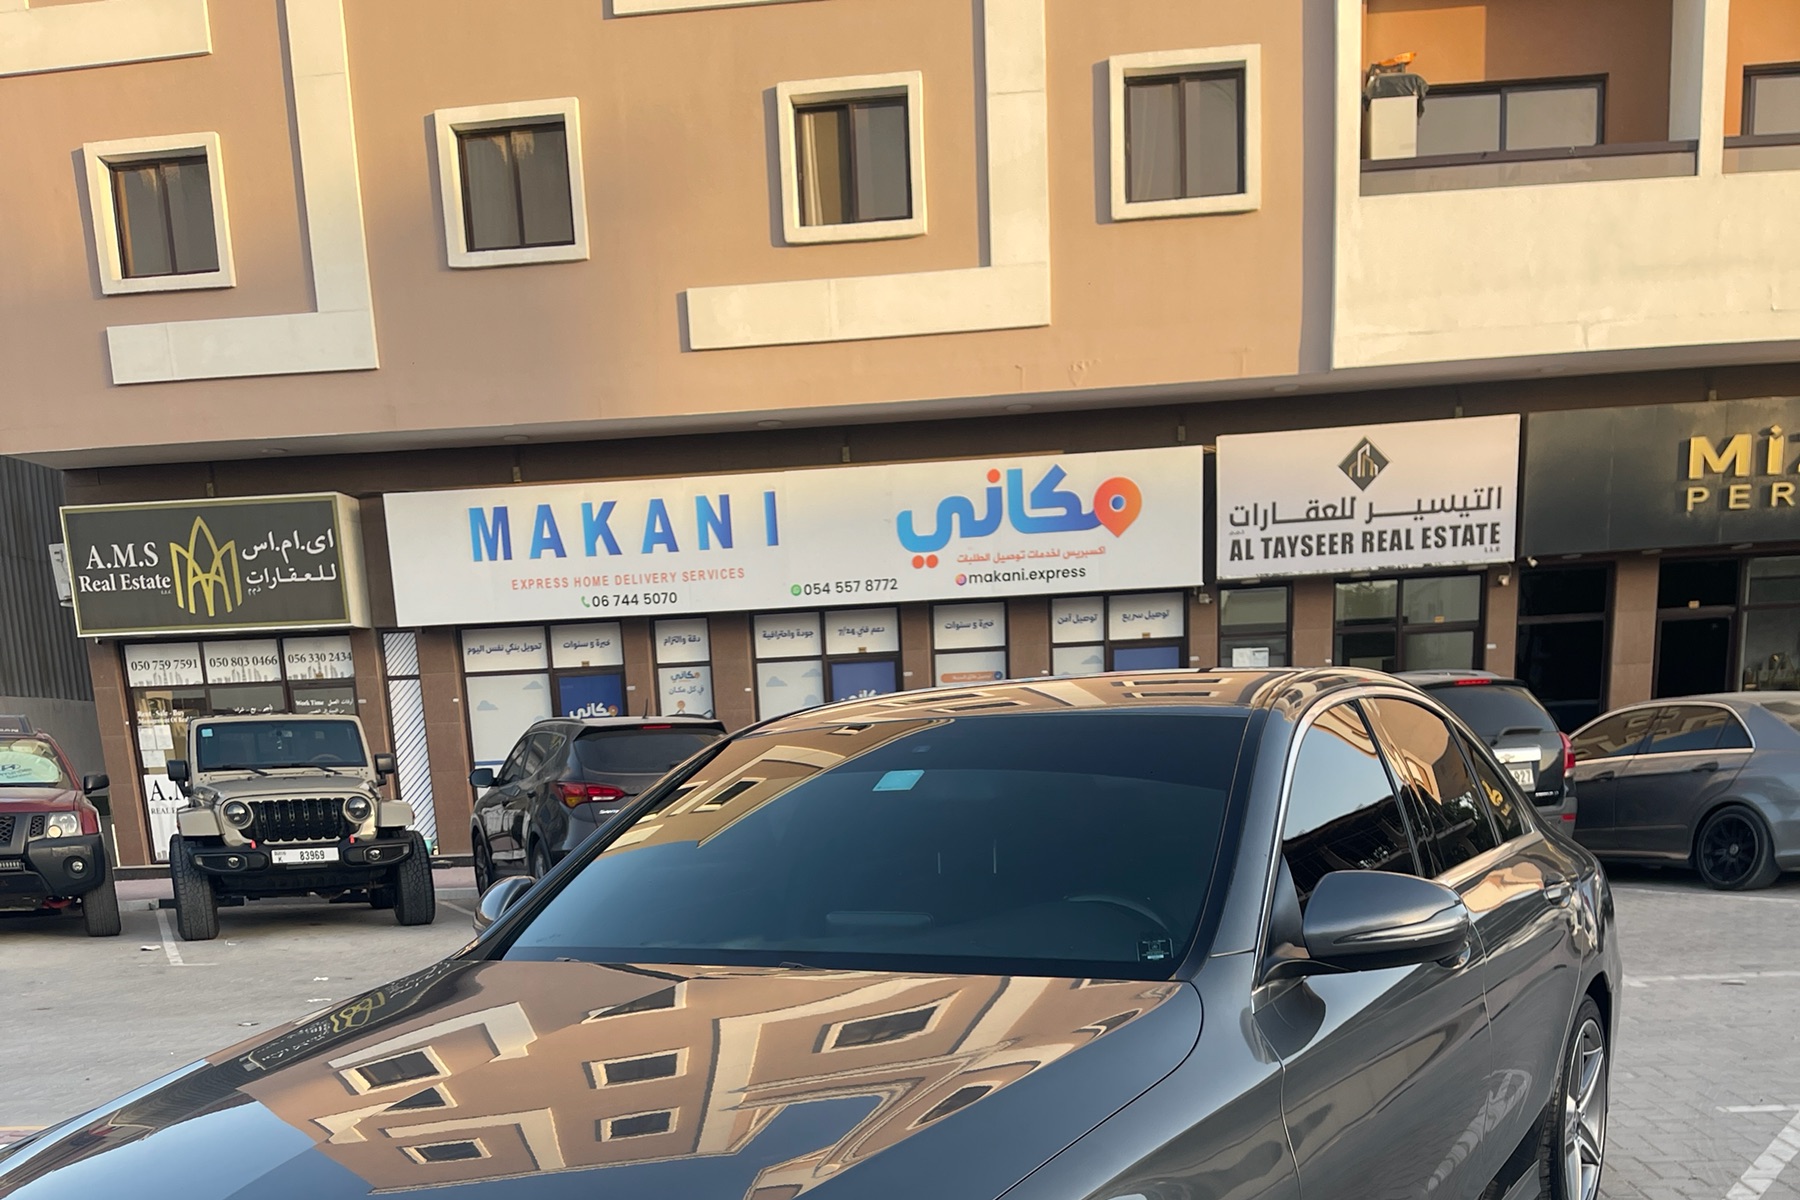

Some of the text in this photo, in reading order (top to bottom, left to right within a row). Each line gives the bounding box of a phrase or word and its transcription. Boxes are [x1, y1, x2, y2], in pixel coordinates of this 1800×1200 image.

[1689, 424, 1800, 480] Mi
[1687, 482, 1796, 512] PER
[1229, 485, 1503, 531] التيسير للعقارات
[896, 464, 1143, 569] مكاني
[468, 491, 779, 562] MAKANI
[1229, 522, 1501, 562] AL TAYSEER REAL ESTATE
[86, 541, 159, 570] A.M.S
[956, 553, 991, 563] الطلبات
[993, 550, 1026, 563] توصيل
[1027, 548, 1060, 560] لخدمات
[246, 563, 336, 589] للعقارات
[511, 567, 746, 590] EXPRESS HOME DELIVERY SERVICES
[968, 566, 1087, 585] makani.express
[78, 573, 172, 593] Real Estate
[803, 578, 898, 597] 054 557 8772
[591, 592, 678, 607] 06 744 5070
[1072, 613, 1098, 623] توصيل
[1121, 609, 1170, 622] توصيل سريع
[870, 626, 885, 634] دعم
[944, 621, 971, 631] سنوات
[796, 629, 814, 639] جودة
[520, 642, 543, 653] تحويل
[563, 639, 588, 650] سنوات
[663, 635, 701, 647] دقة والتزام
[467, 645, 485, 655] اليوم
[486, 644, 504, 655] نفس
[131, 658, 198, 671] 050 759 7591
[209, 655, 278, 668] 050 803 0466
[288, 652, 352, 664] 056 330 2434
[300, 850, 325, 860] 83969
